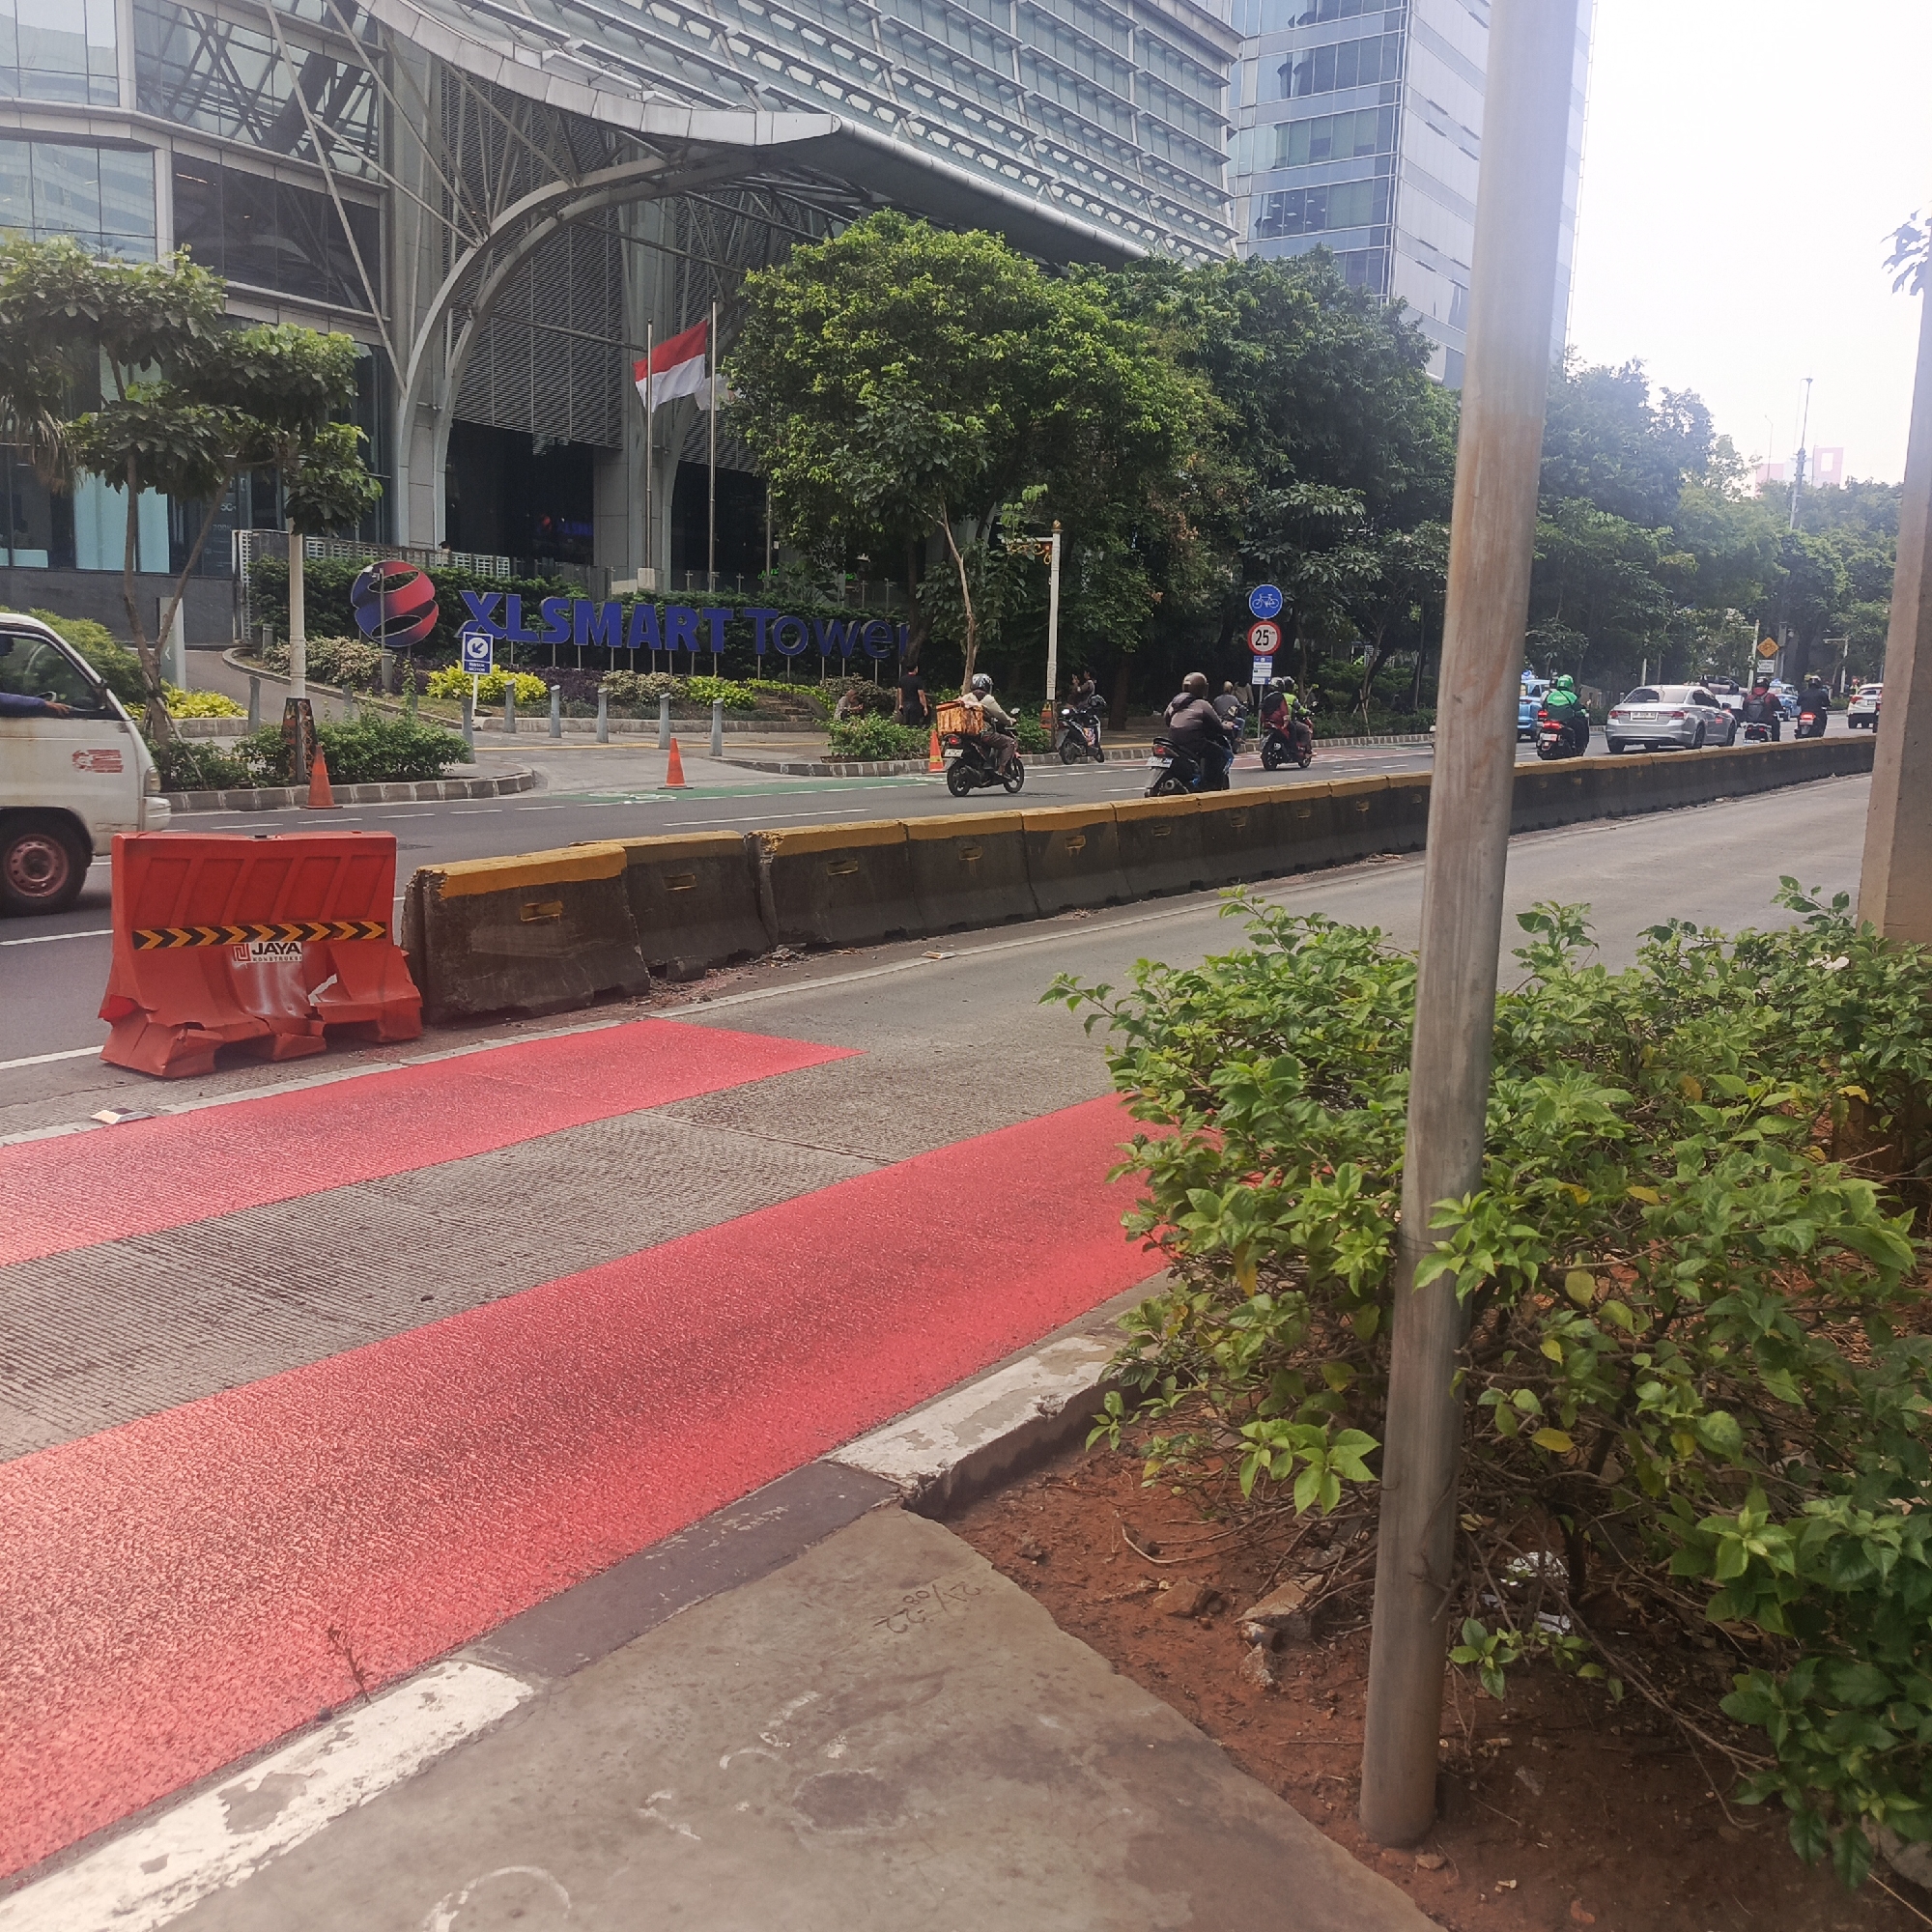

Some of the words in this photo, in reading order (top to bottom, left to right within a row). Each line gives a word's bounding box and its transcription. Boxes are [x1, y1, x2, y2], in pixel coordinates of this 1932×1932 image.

[456, 590, 734, 653] XLSMART
[1255, 629, 1269, 646] 25
[251, 942, 302, 955] JAYA
